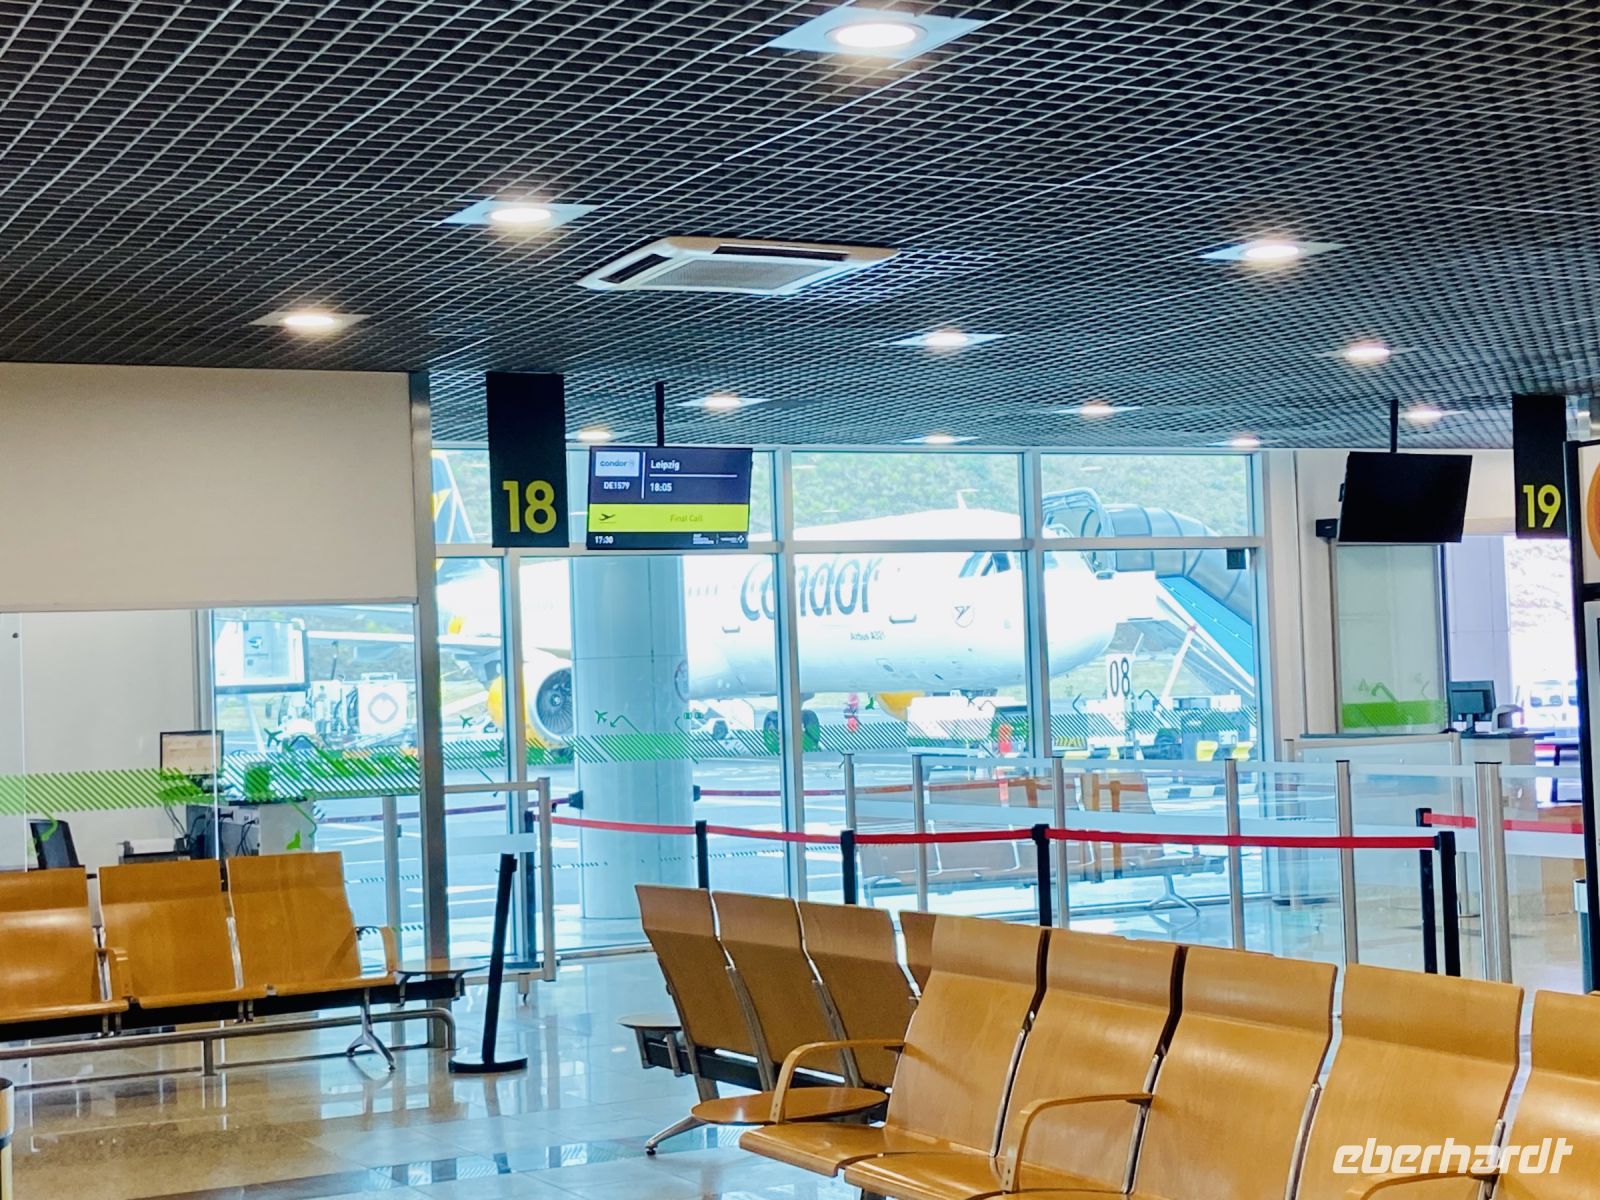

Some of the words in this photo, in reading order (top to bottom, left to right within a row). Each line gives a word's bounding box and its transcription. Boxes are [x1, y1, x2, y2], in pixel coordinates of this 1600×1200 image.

[600, 459, 627, 467] condor
[650, 459, 680, 471] Leipzig
[603, 481, 630, 490] DE1579
[650, 482, 673, 492] 18:05
[502, 480, 557, 533] 18
[1523, 484, 1561, 528] 19
[670, 514, 688, 522] Final
[689, 514, 703, 522] Call
[1109, 657, 1131, 697] 08
